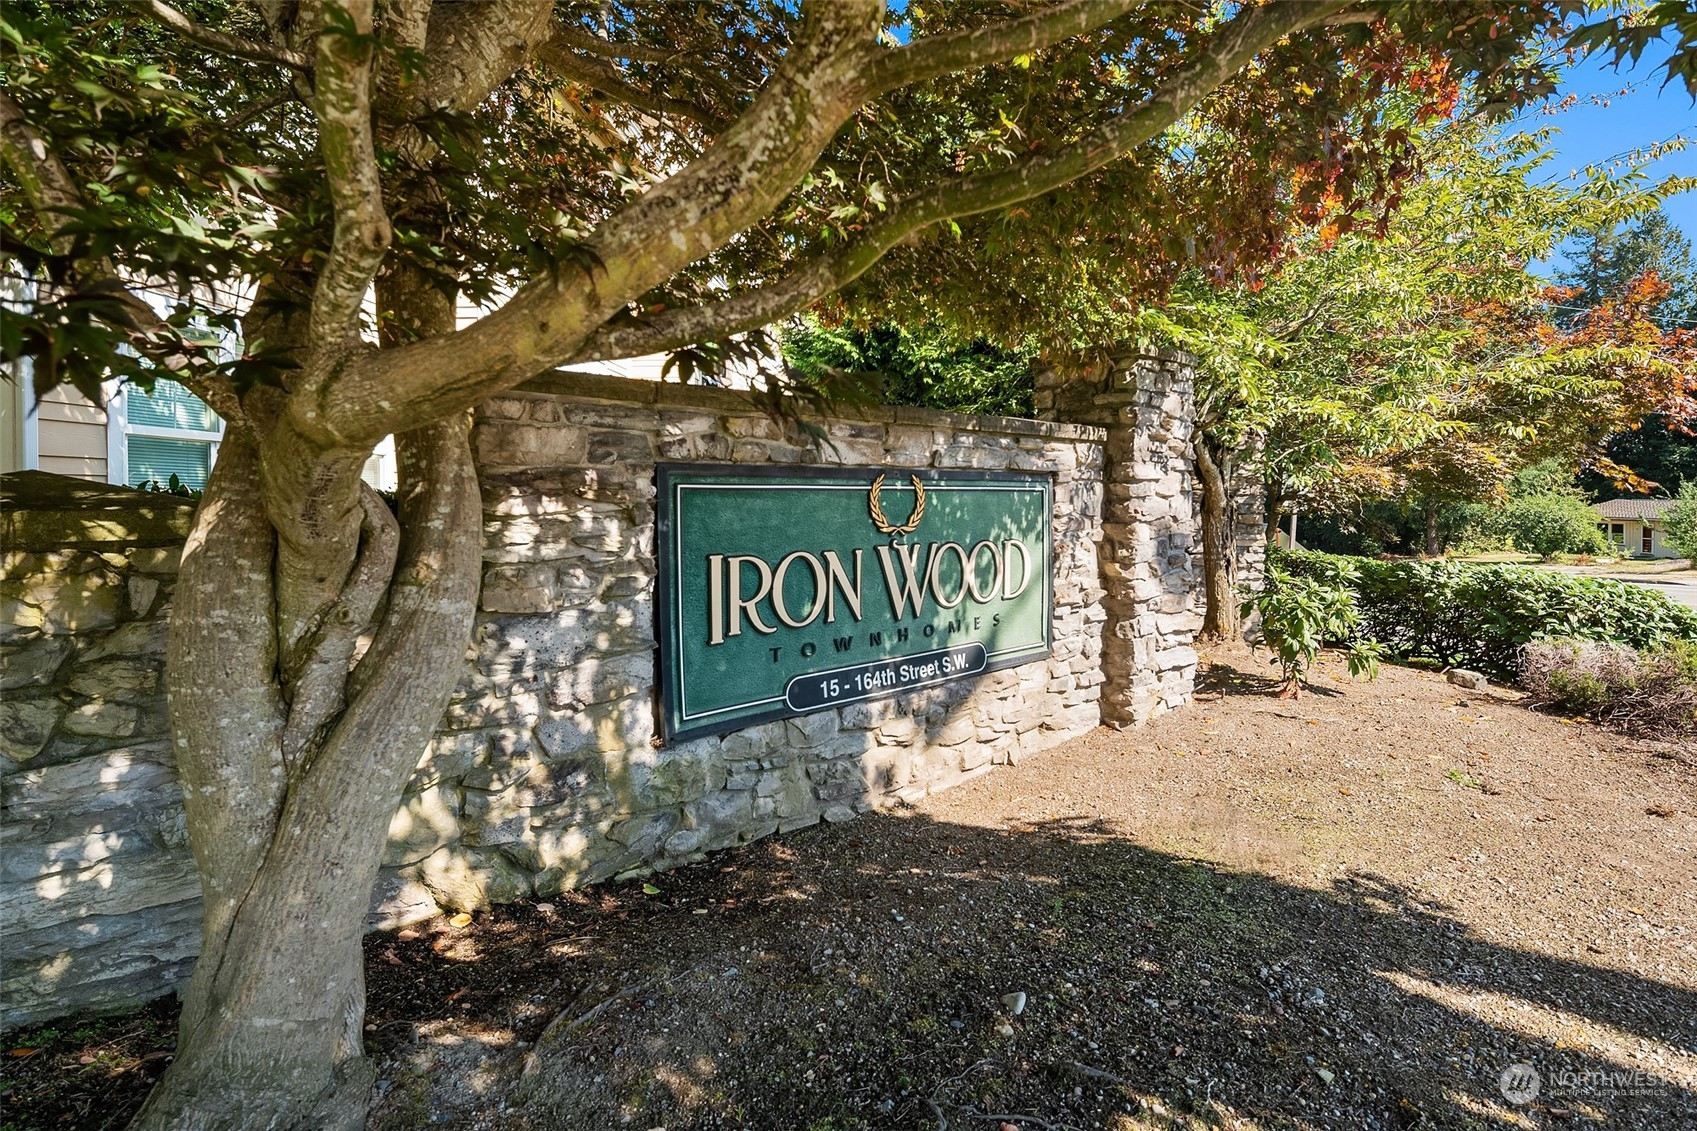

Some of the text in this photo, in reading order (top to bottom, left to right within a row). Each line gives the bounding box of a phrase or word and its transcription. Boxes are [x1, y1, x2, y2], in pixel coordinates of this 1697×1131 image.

[707, 539, 1032, 646] IRON WOOD
[769, 613, 1002, 664] TOWNHOMES
[820, 679, 840, 699] 15
[854, 669, 896, 692] 164th
[900, 660, 940, 685] Street
[942, 653, 970, 674] S.W.
